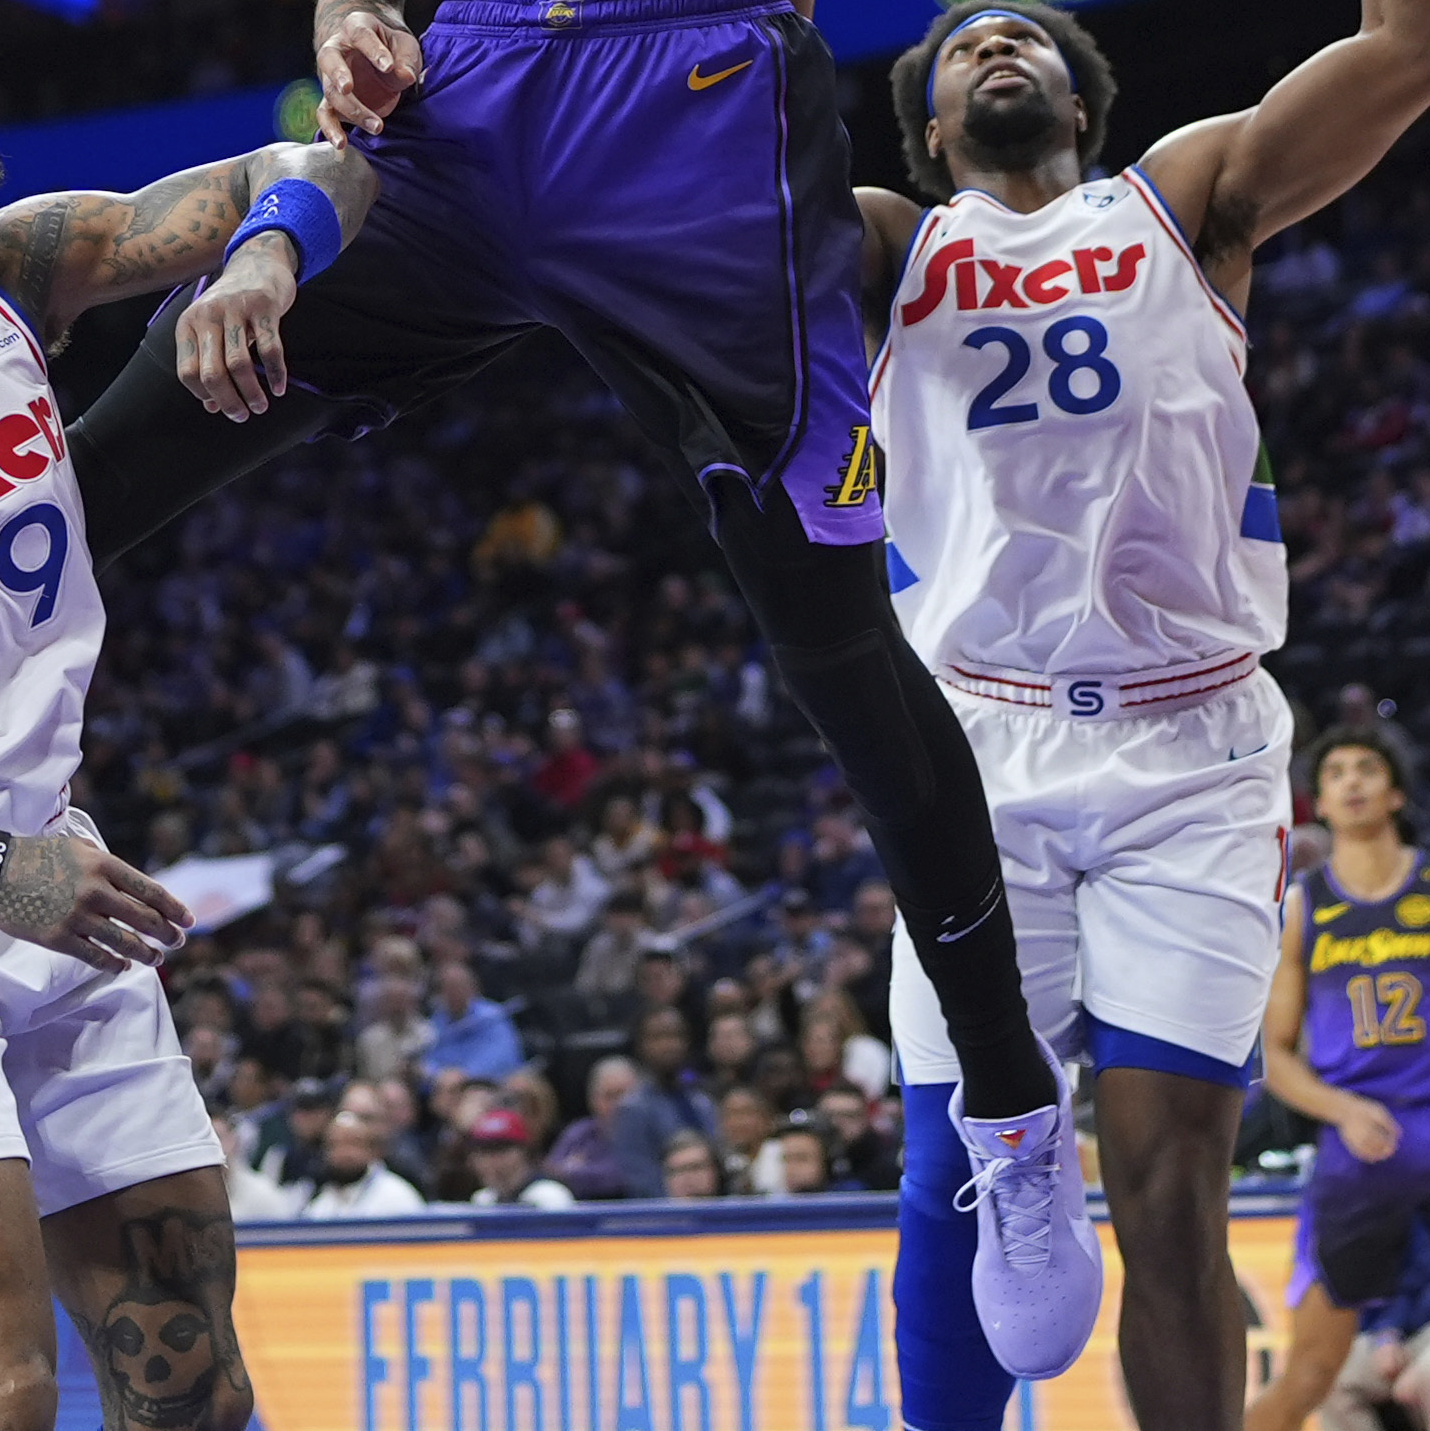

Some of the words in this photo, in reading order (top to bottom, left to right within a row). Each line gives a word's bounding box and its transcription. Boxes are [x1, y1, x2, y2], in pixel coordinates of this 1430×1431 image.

[900, 237, 1148, 327] Sixers
[962, 315, 1122, 431] 28
[1346, 972, 1427, 1050] 12
[361, 1271, 768, 1431] FEBRUARY
